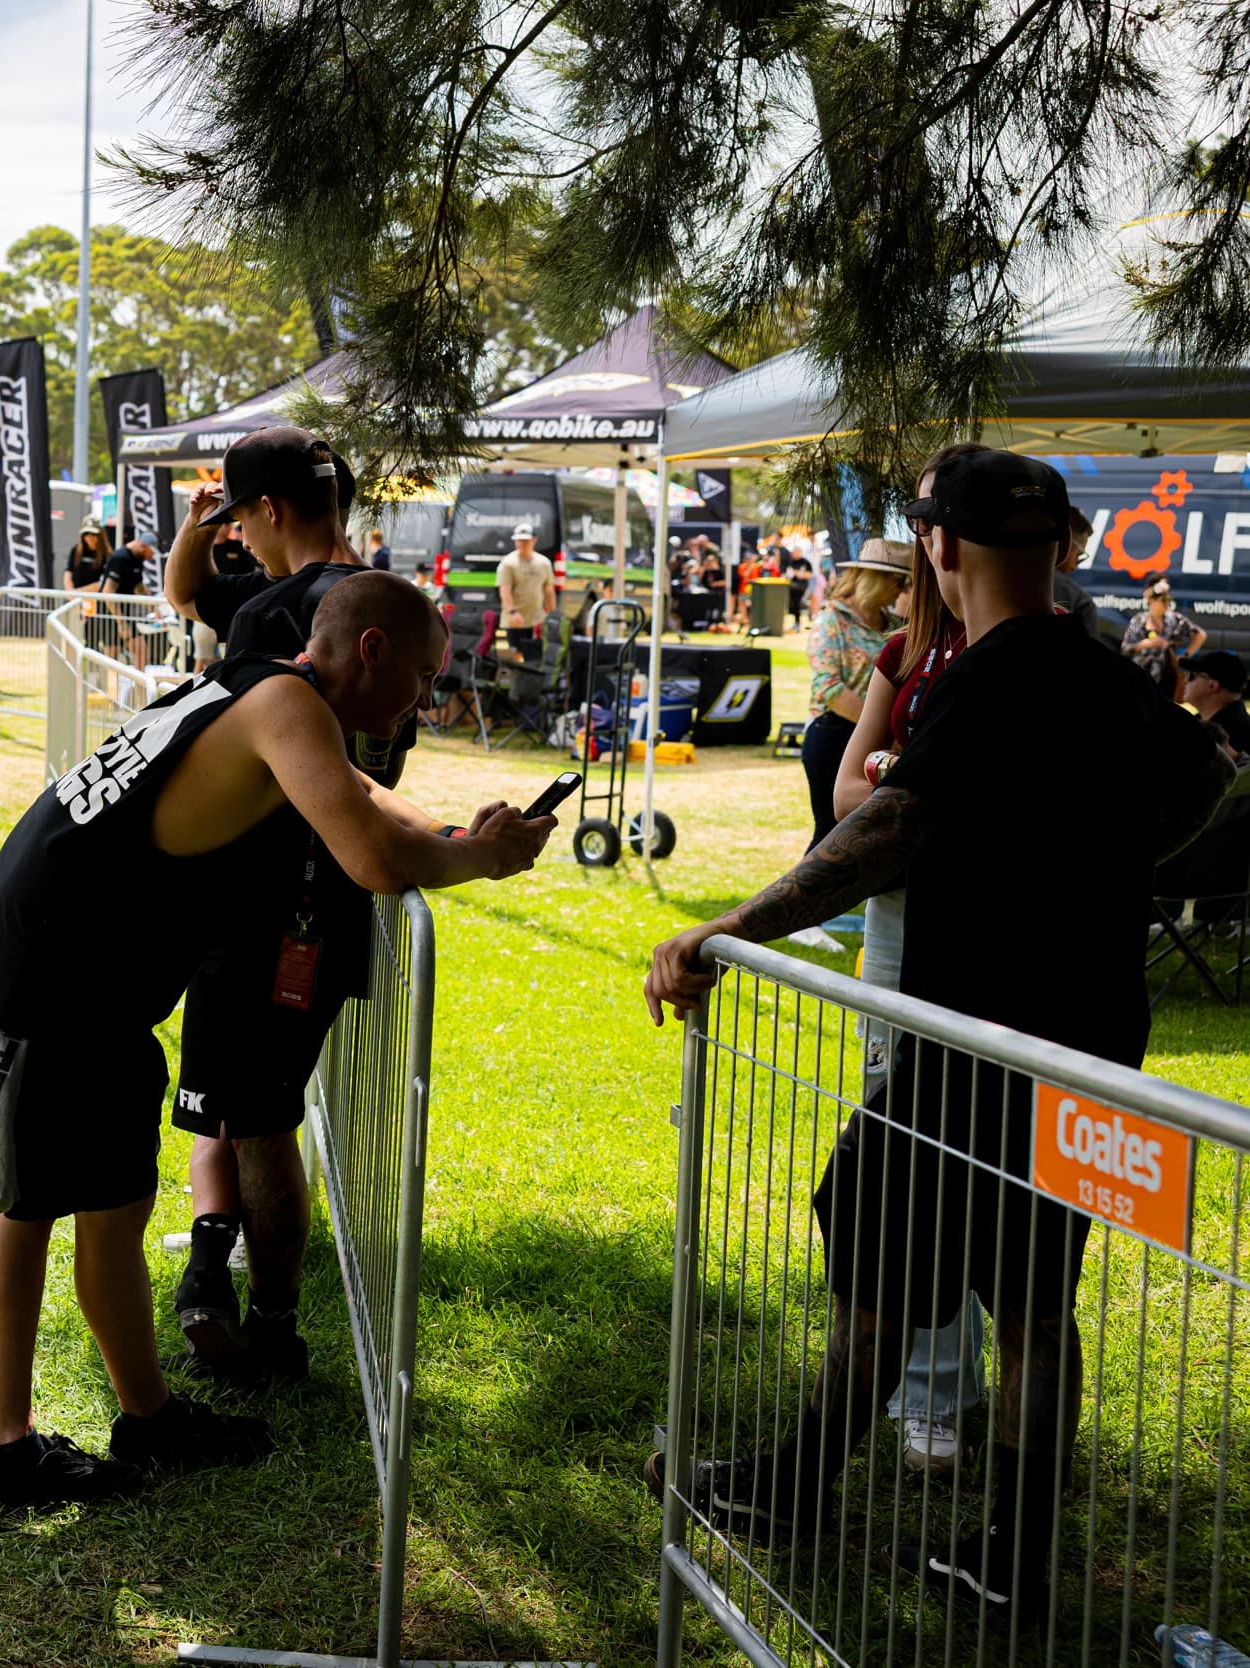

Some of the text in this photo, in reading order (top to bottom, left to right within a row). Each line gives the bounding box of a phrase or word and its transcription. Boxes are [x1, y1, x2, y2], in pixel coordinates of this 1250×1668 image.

[1193, 599, 1250, 618] wolfspo
[179, 1087, 207, 1114] FK
[1057, 1097, 1163, 1193] Coates
[1079, 1179, 1134, 1223] 13 15 52
